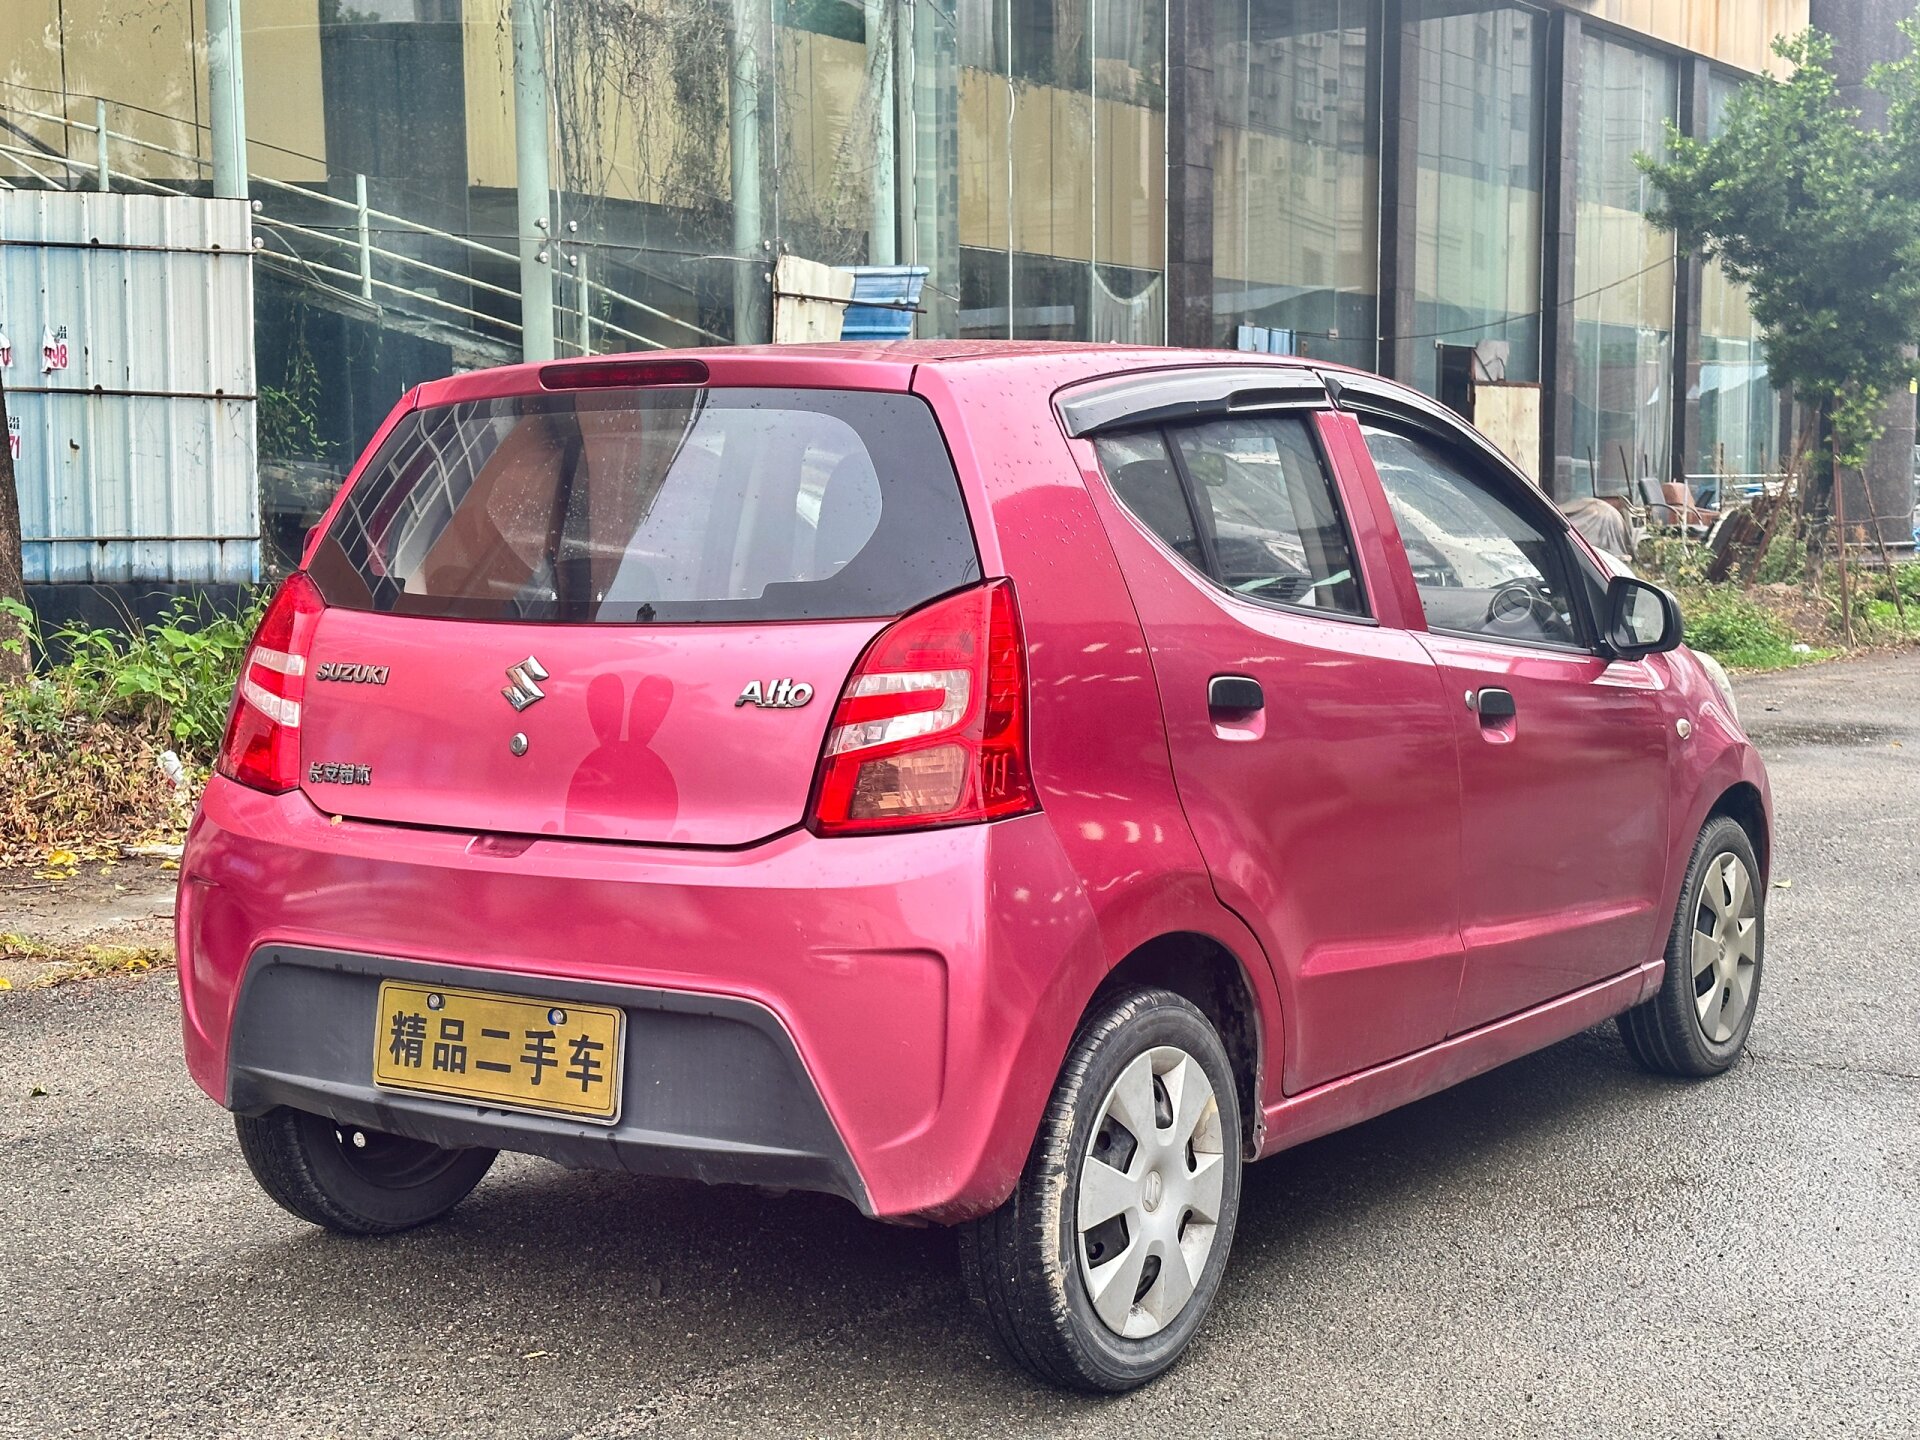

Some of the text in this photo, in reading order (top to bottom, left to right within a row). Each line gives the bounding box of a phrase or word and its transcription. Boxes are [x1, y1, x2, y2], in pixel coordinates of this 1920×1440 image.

[316, 662, 390, 685] SUZUKI
[735, 677, 814, 708] Alto
[389, 1010, 604, 1093] 精品二手车
